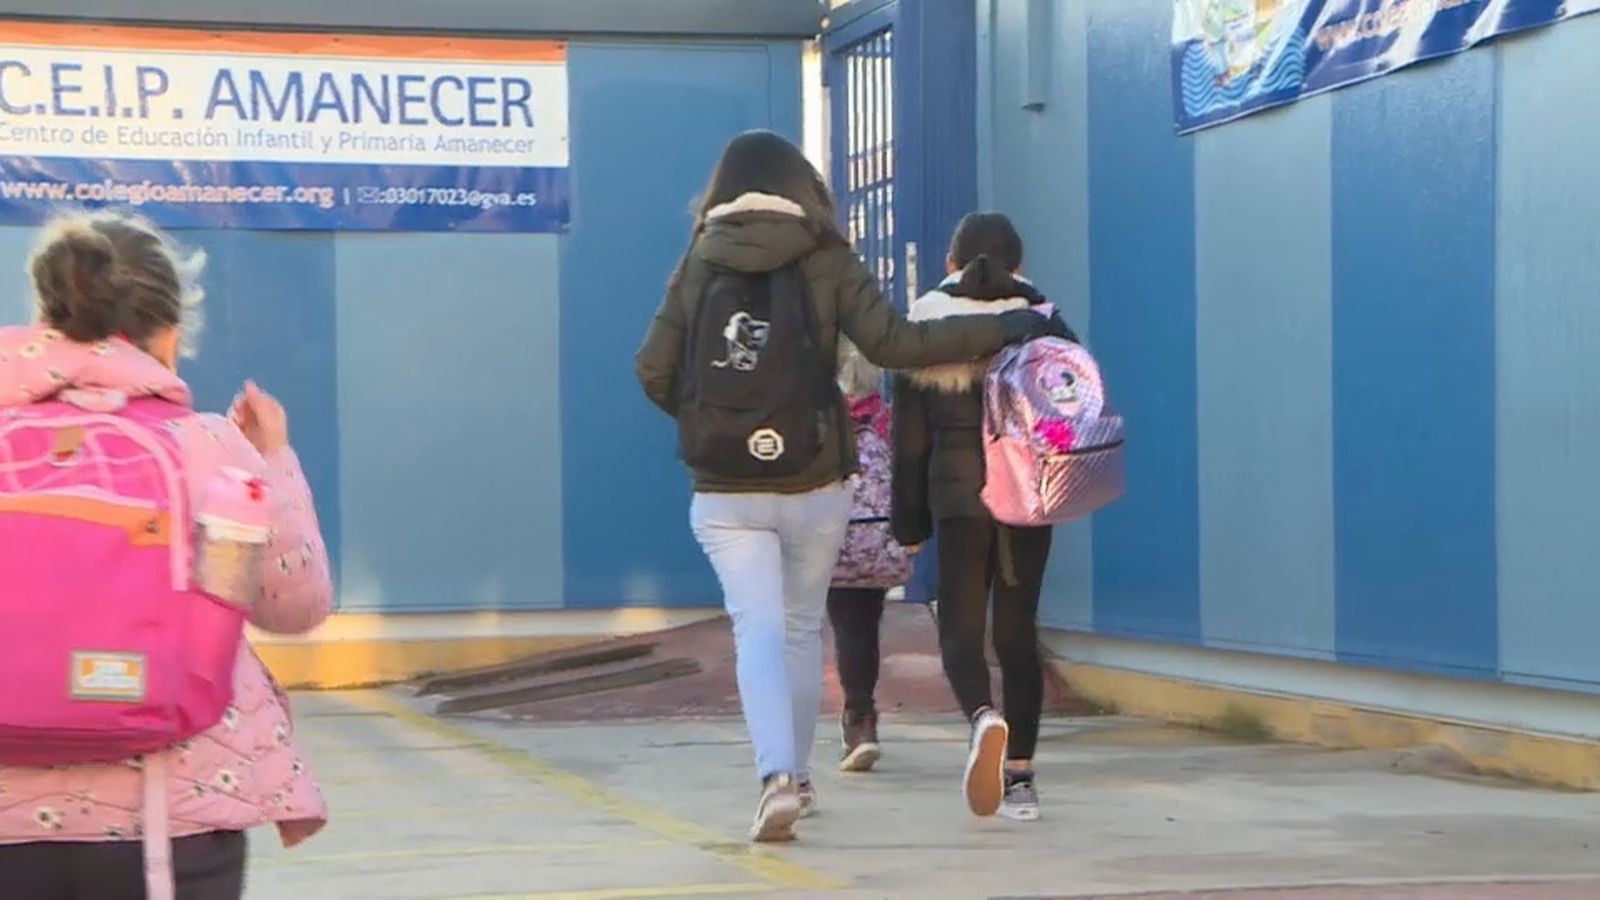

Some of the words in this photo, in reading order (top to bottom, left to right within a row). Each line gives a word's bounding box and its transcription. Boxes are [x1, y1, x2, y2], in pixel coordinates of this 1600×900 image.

[0, 60, 183, 119] C.E.I.P.
[204, 69, 534, 127] AMANECER
[81, 125, 109, 145] de
[117, 126, 229, 147] Educación
[237, 129, 314, 149] Infantil
[320, 135, 333, 154] y
[339, 131, 426, 152] Primaria
[434, 134, 536, 155] Amanecer
[0, 179, 335, 209] www.colegioamanecer.org
